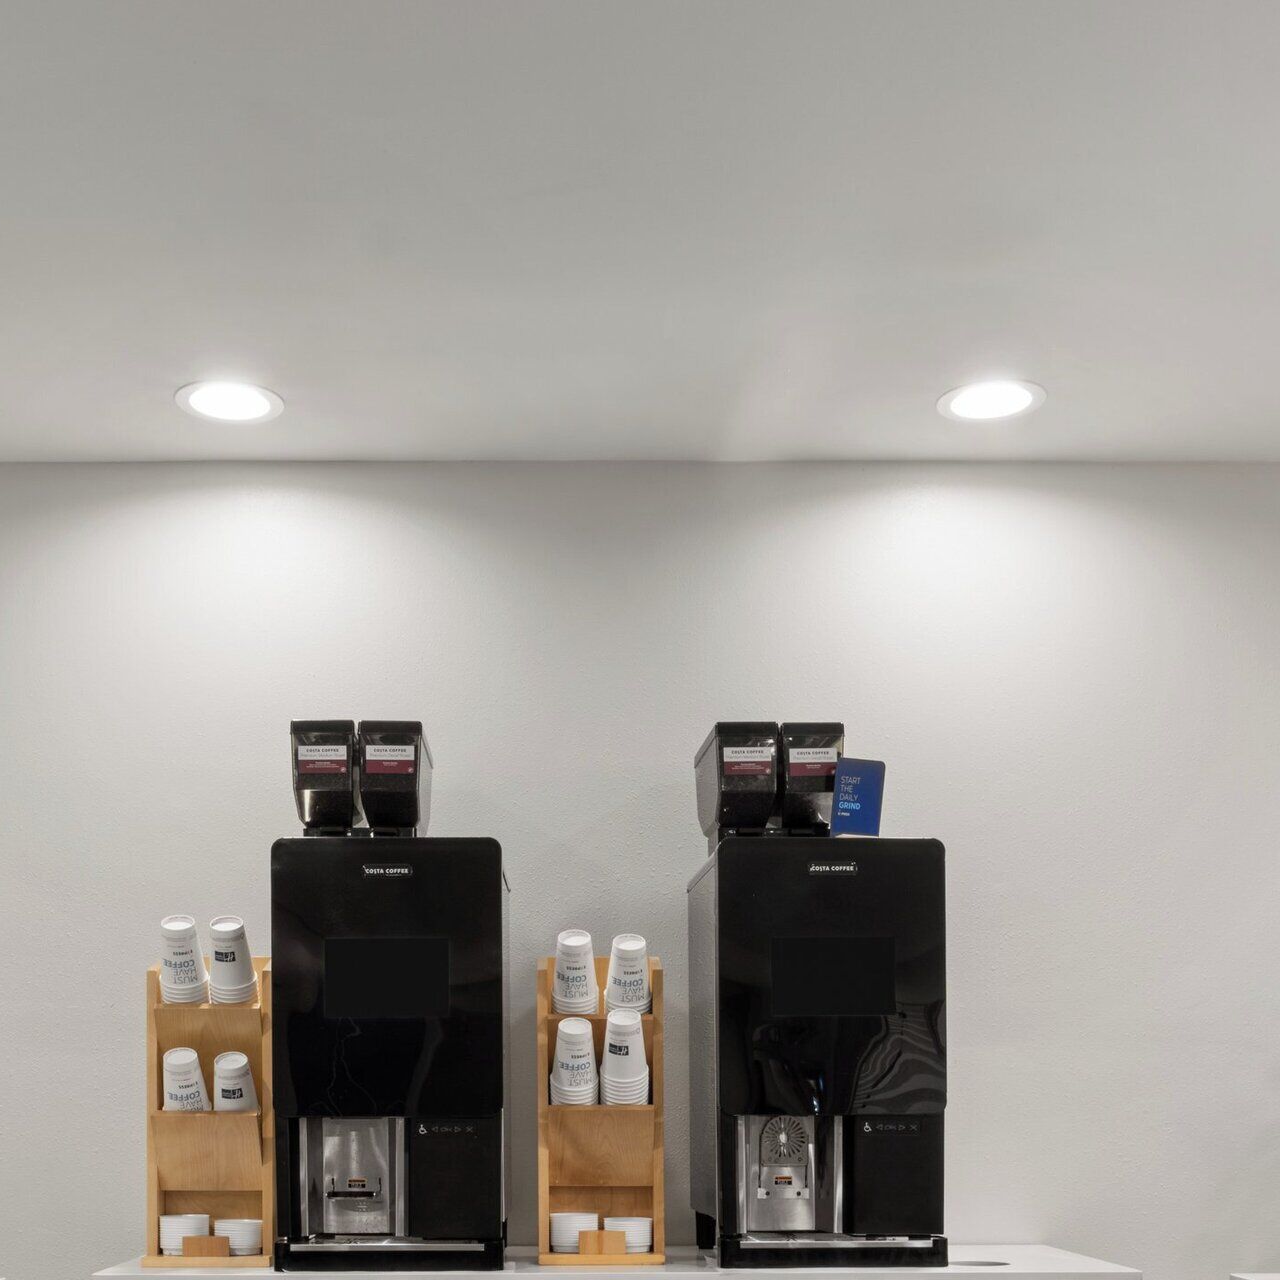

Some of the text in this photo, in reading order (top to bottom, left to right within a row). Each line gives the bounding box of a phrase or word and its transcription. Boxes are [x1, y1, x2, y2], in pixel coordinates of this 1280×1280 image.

[840, 776, 861, 784] START
[840, 784, 854, 793] THE
[839, 793, 859, 801] DAILY
[838, 801, 861, 810] GRIND
